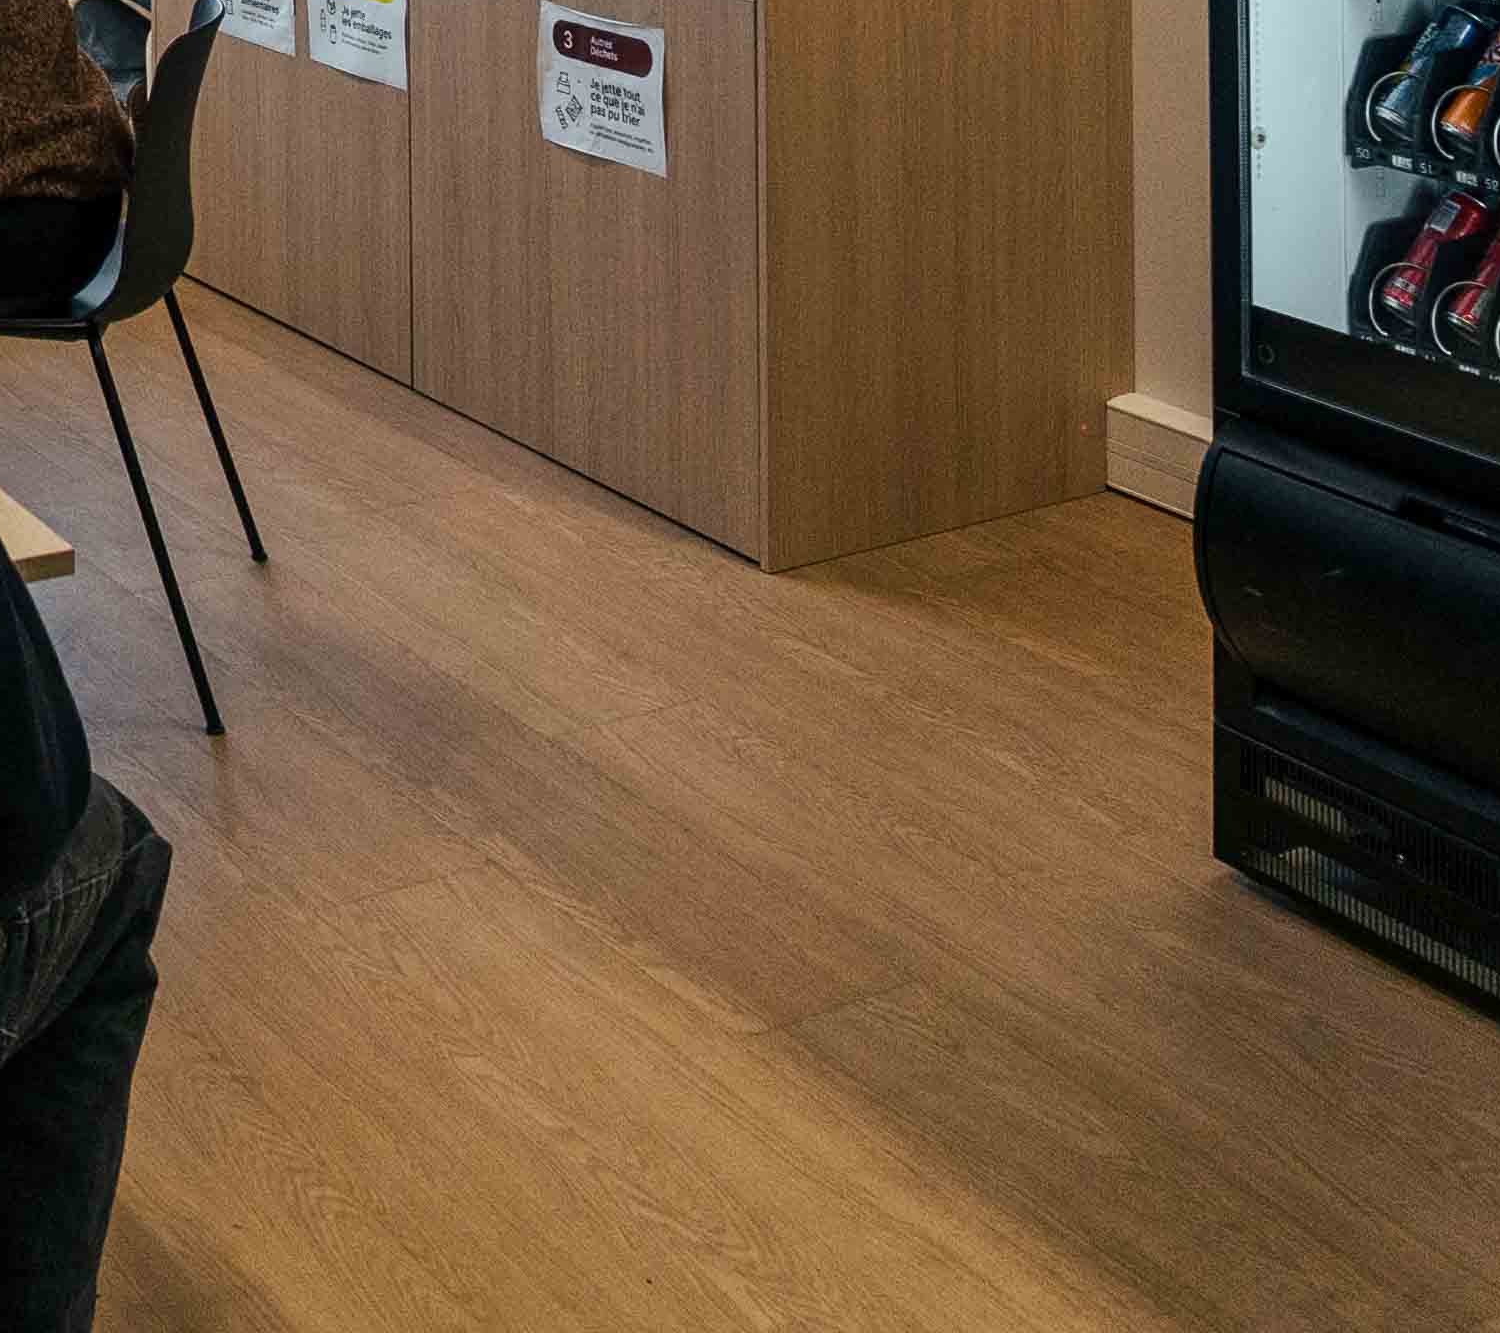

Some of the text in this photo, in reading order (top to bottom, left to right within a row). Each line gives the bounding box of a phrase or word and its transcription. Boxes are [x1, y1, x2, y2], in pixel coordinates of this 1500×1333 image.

[352, 21, 392, 41] emballages
[563, 30, 574, 49] 3
[590, 47, 619, 62] Déchets
[590, 78, 641, 102] Je jette tout
[590, 92, 601, 102] ce
[603, 96, 619, 110] que
[620, 99, 629, 113] je
[590, 104, 641, 126] pas pu trier
[1419, 163, 1433, 175] 51
